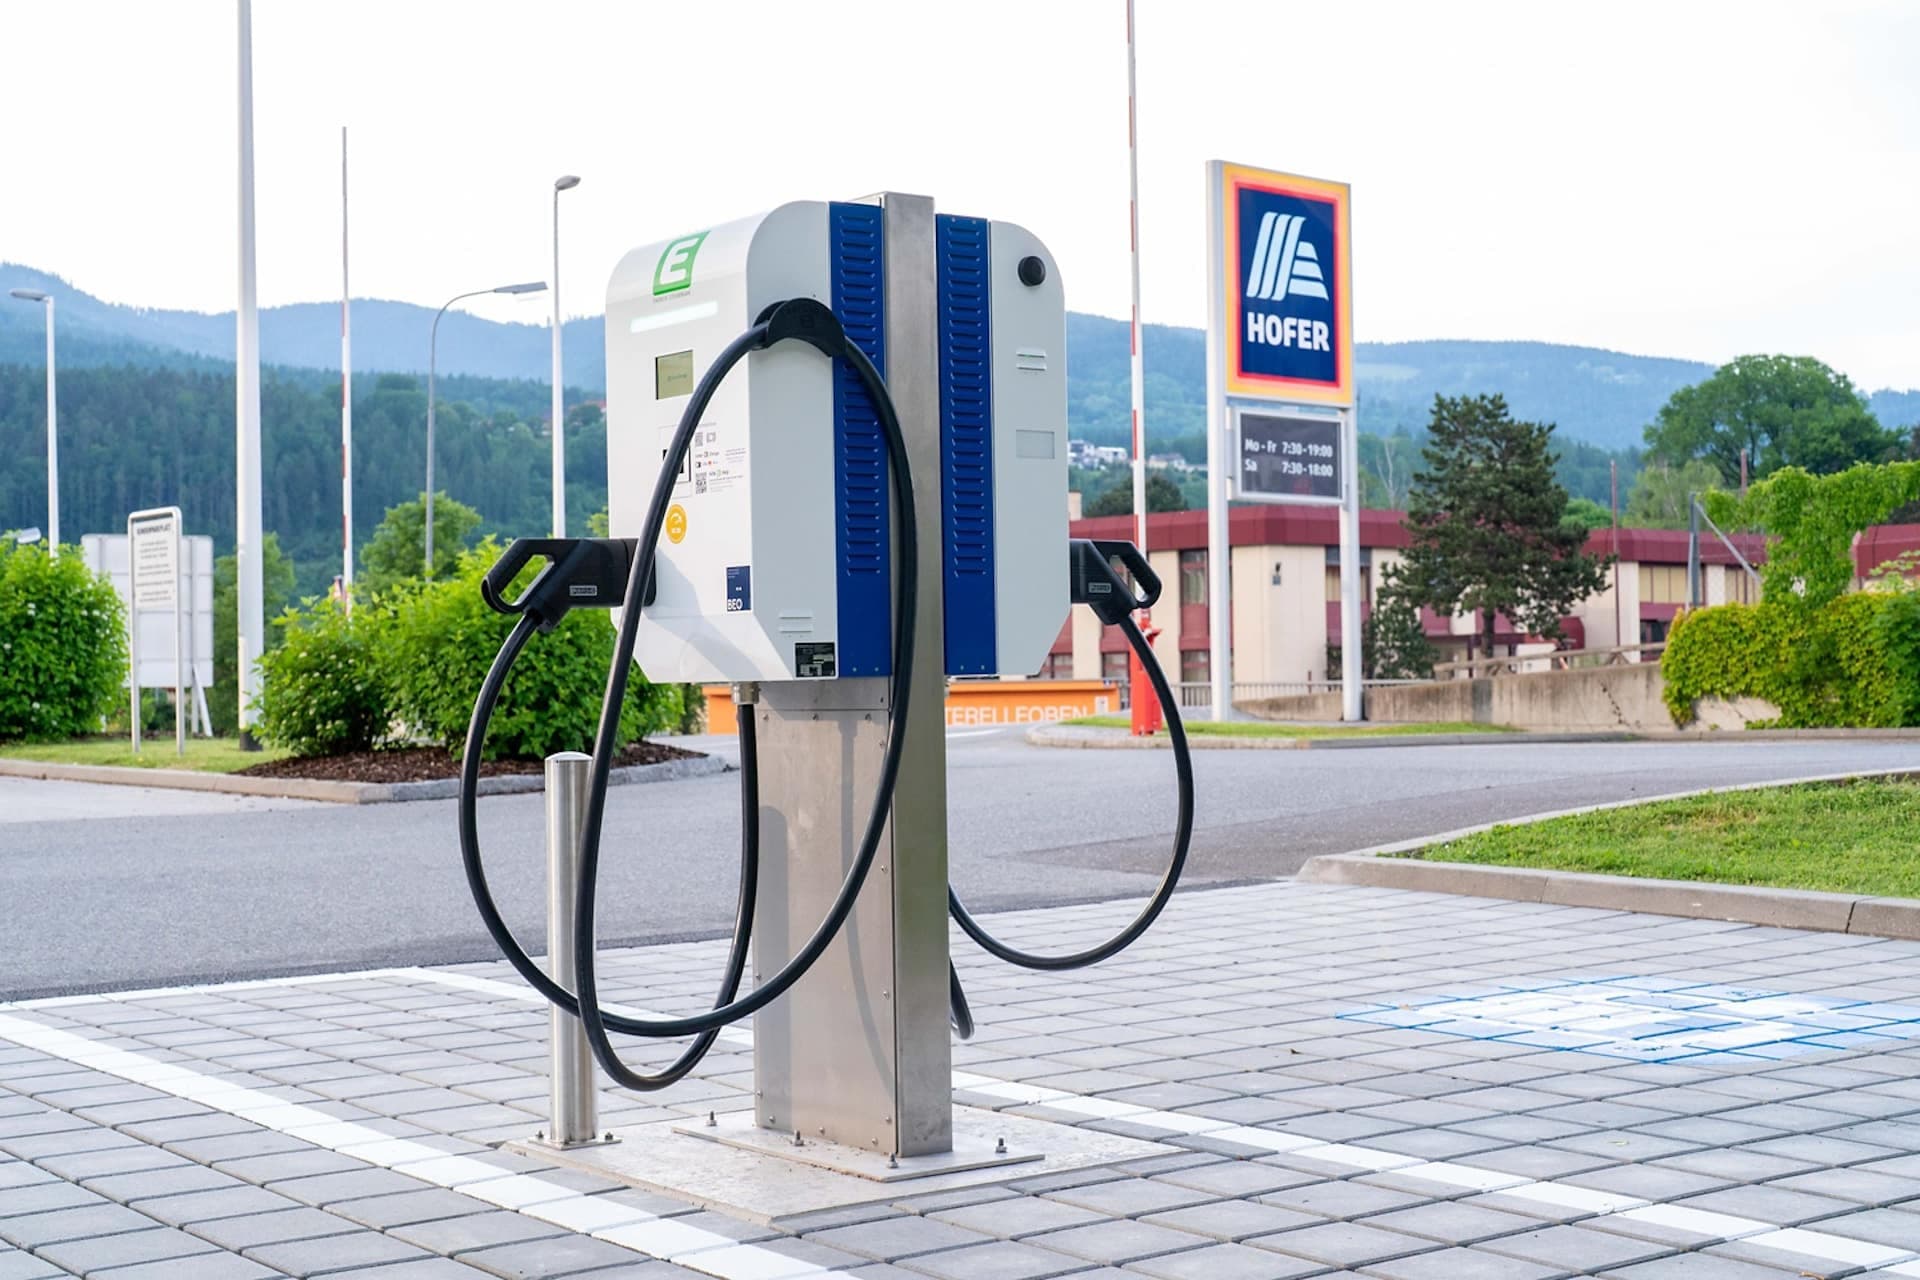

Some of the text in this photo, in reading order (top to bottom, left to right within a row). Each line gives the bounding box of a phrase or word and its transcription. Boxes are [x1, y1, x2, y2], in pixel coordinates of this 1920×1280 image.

[1247, 312, 1330, 352] HOFER
[1245, 438, 1259, 452] Mo
[1267, 440, 1277, 453] Fr
[1245, 458, 1257, 472] Sa
